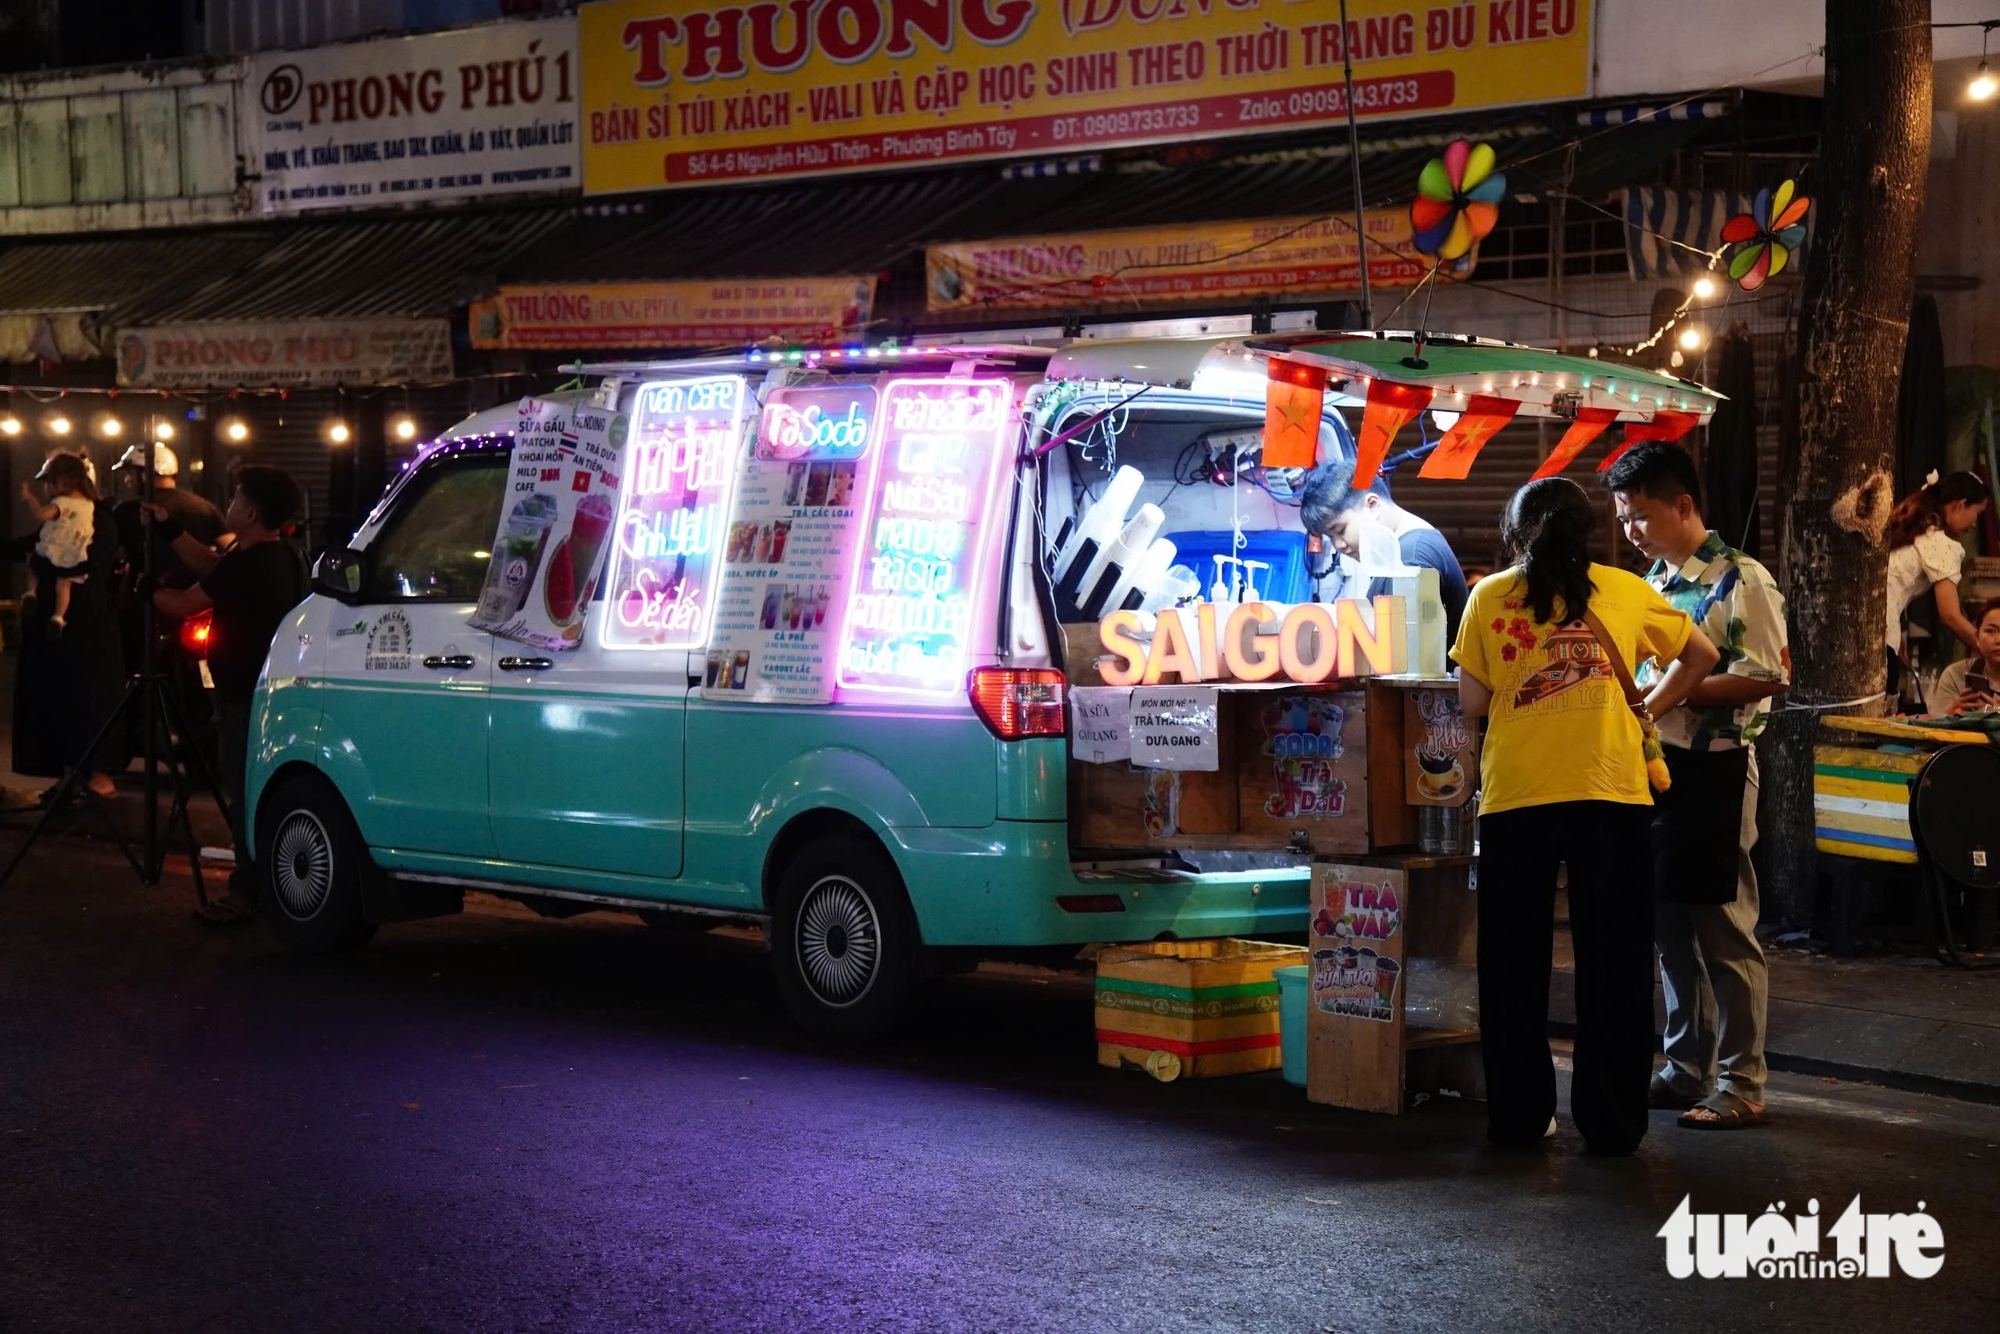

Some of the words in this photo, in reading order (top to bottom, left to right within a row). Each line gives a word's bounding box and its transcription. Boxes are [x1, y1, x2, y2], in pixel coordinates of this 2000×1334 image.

[307, 68, 446, 125] PHONG
[459, 39, 546, 111] PHÚ
[554, 50, 574, 103] 1
[677, 94, 715, 136] TÚI
[723, 88, 790, 131] XÁCH
[808, 82, 863, 122] VALI
[871, 71, 905, 116] VÀ
[914, 64, 969, 118] CẶP
[978, 62, 1036, 110] HỌC
[1045, 51, 1118, 97] SINH
[1127, 40, 1205, 87] THEO
[1216, 21, 1288, 77] THỜI
[1300, 12, 1415, 67] TRANG
[709, 153, 735, 172] 4-6
[1084, 104, 1200, 137] 0909.733.733
[1239, 98, 1285, 121] Zalo:
[153, 336, 275, 369] PHONG
[543, 415, 566, 433] GẤU
[799, 401, 868, 447] Soda
[521, 438, 555, 447] MATCHA
[518, 452, 544, 462] KHOAI
[516, 467, 538, 477] MILO
[515, 482, 536, 492] CAFE
[1098, 595, 1395, 687] SAIGON
[1090, 704, 1110, 718] SỮA
[1417, 690, 1448, 722] Cà
[1134, 712, 1153, 727] TRÀ
[1146, 735, 1169, 747] DƯA
[1170, 735, 1201, 747] GANG
[1274, 733, 1332, 758] SODA
[1300, 761, 1332, 784] Trà
[1347, 880, 1399, 911] TRÀ
